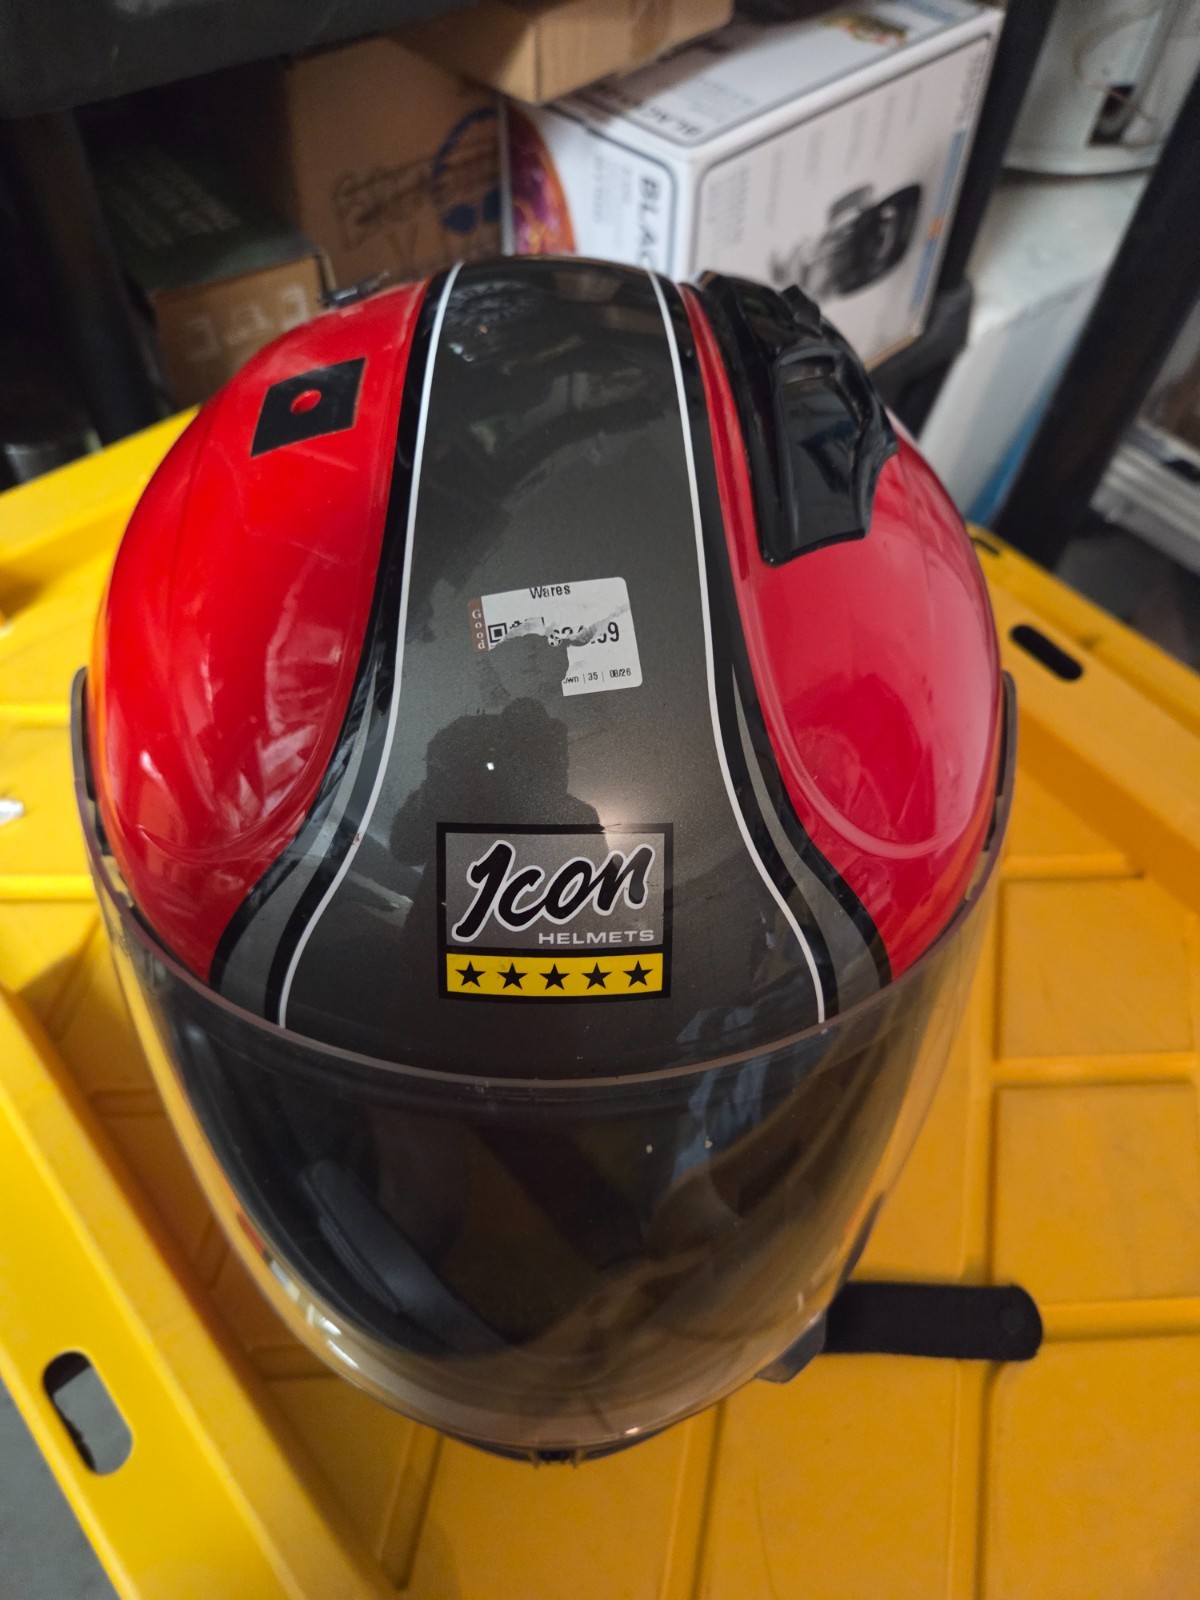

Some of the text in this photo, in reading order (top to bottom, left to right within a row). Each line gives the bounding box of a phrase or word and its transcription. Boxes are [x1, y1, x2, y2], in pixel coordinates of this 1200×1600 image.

[529, 585, 571, 599] Wares
[472, 609, 485, 650] Good
[587, 671, 598, 681] 35
[452, 840, 655, 942] Icon
[538, 929, 655, 944] HELMETS
